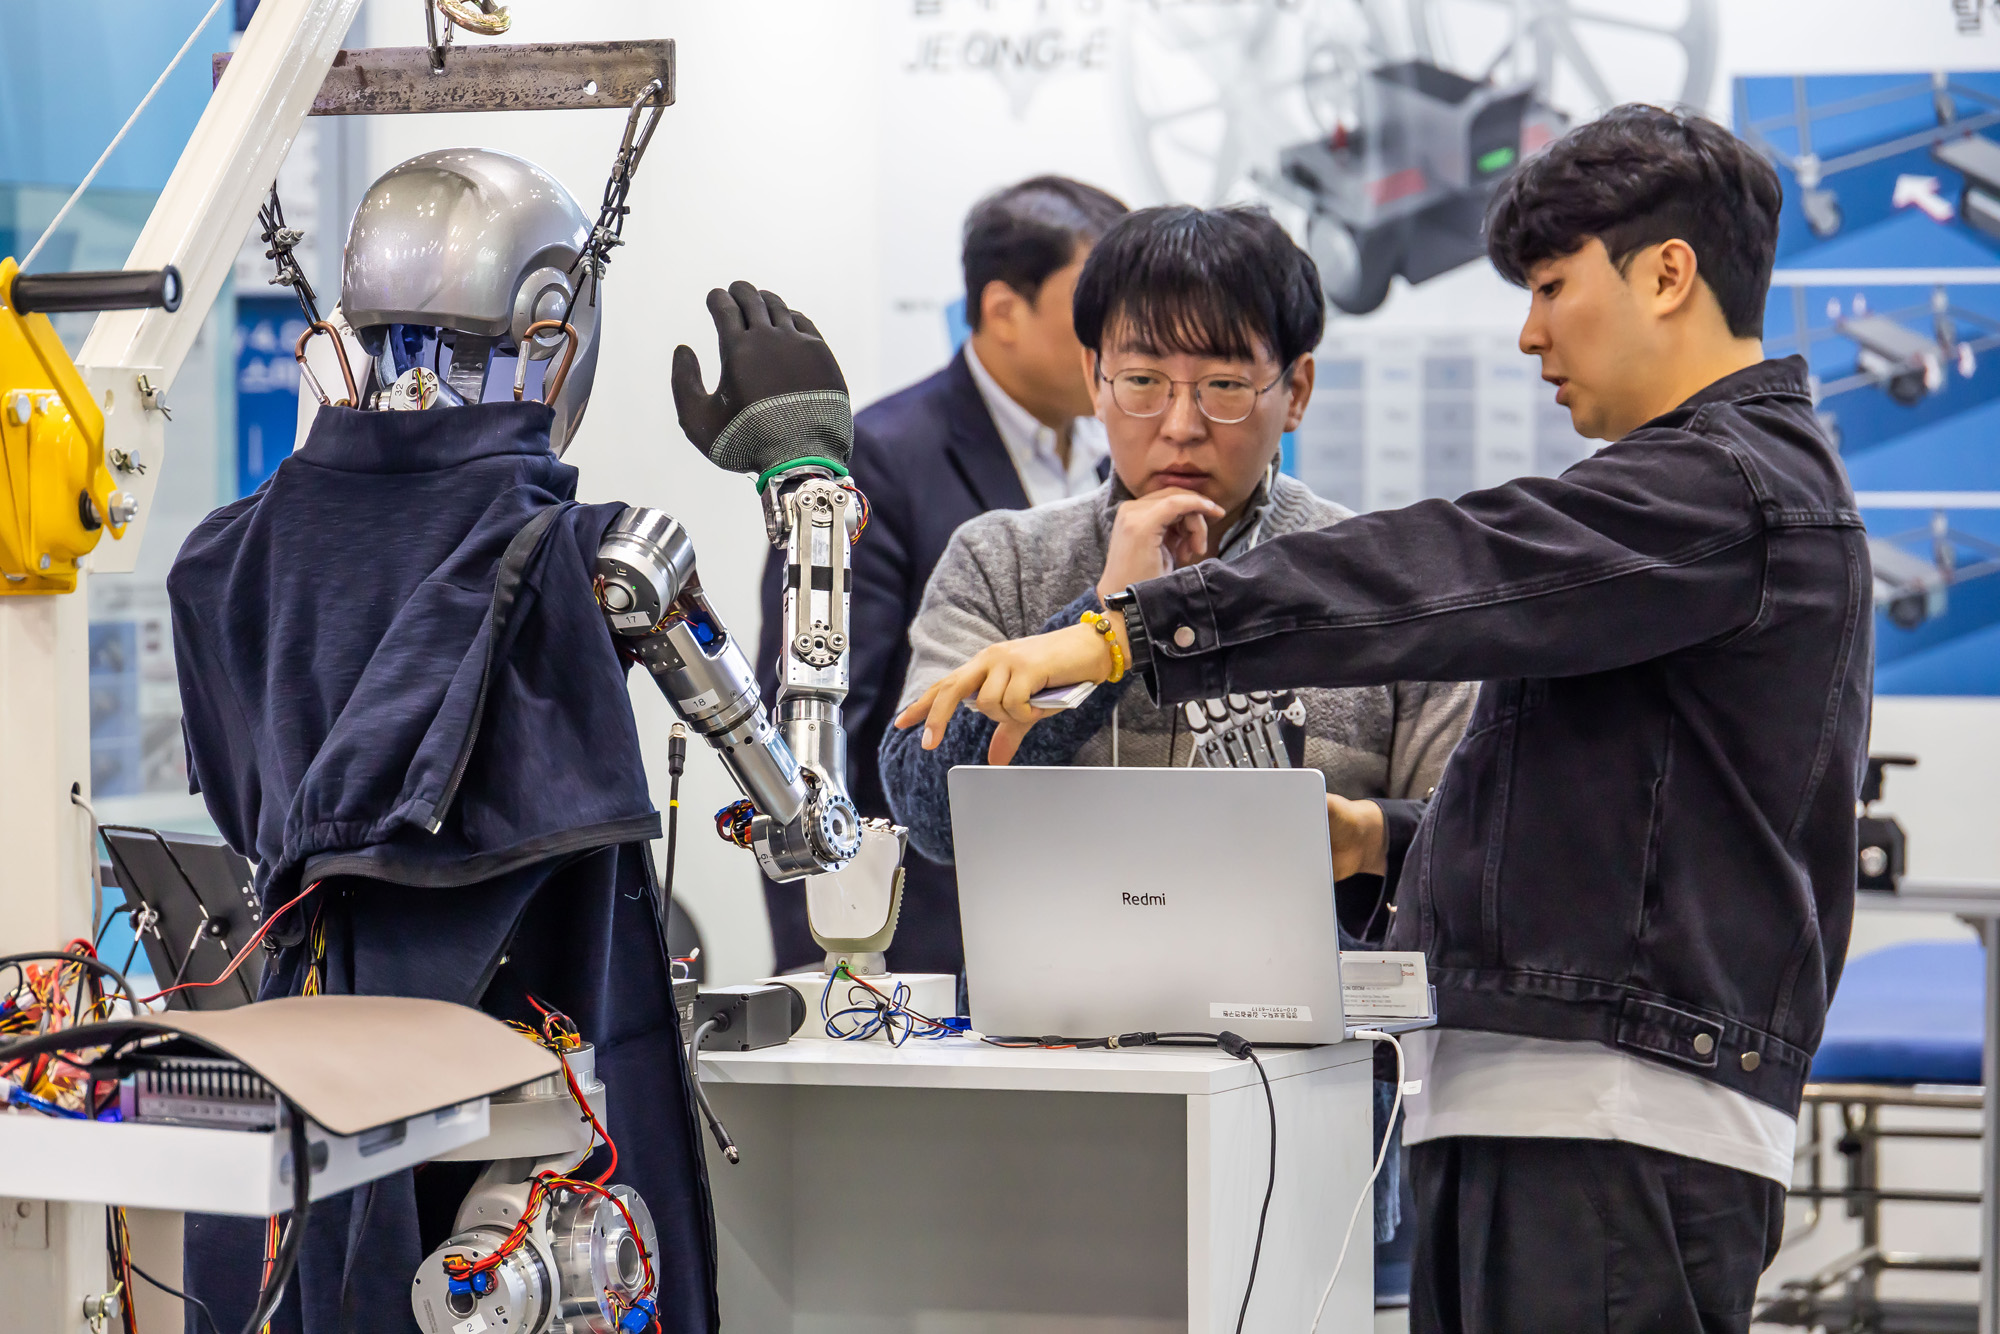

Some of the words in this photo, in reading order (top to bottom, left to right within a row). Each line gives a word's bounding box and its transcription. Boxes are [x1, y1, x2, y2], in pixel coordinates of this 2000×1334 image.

[395, 383, 404, 397] 32
[625, 615, 637, 624] 17
[693, 698, 707, 708] 18
[760, 853, 772, 865] 19
[1122, 892, 1166, 906] Redmi
[466, 1322, 475, 1333] 2
